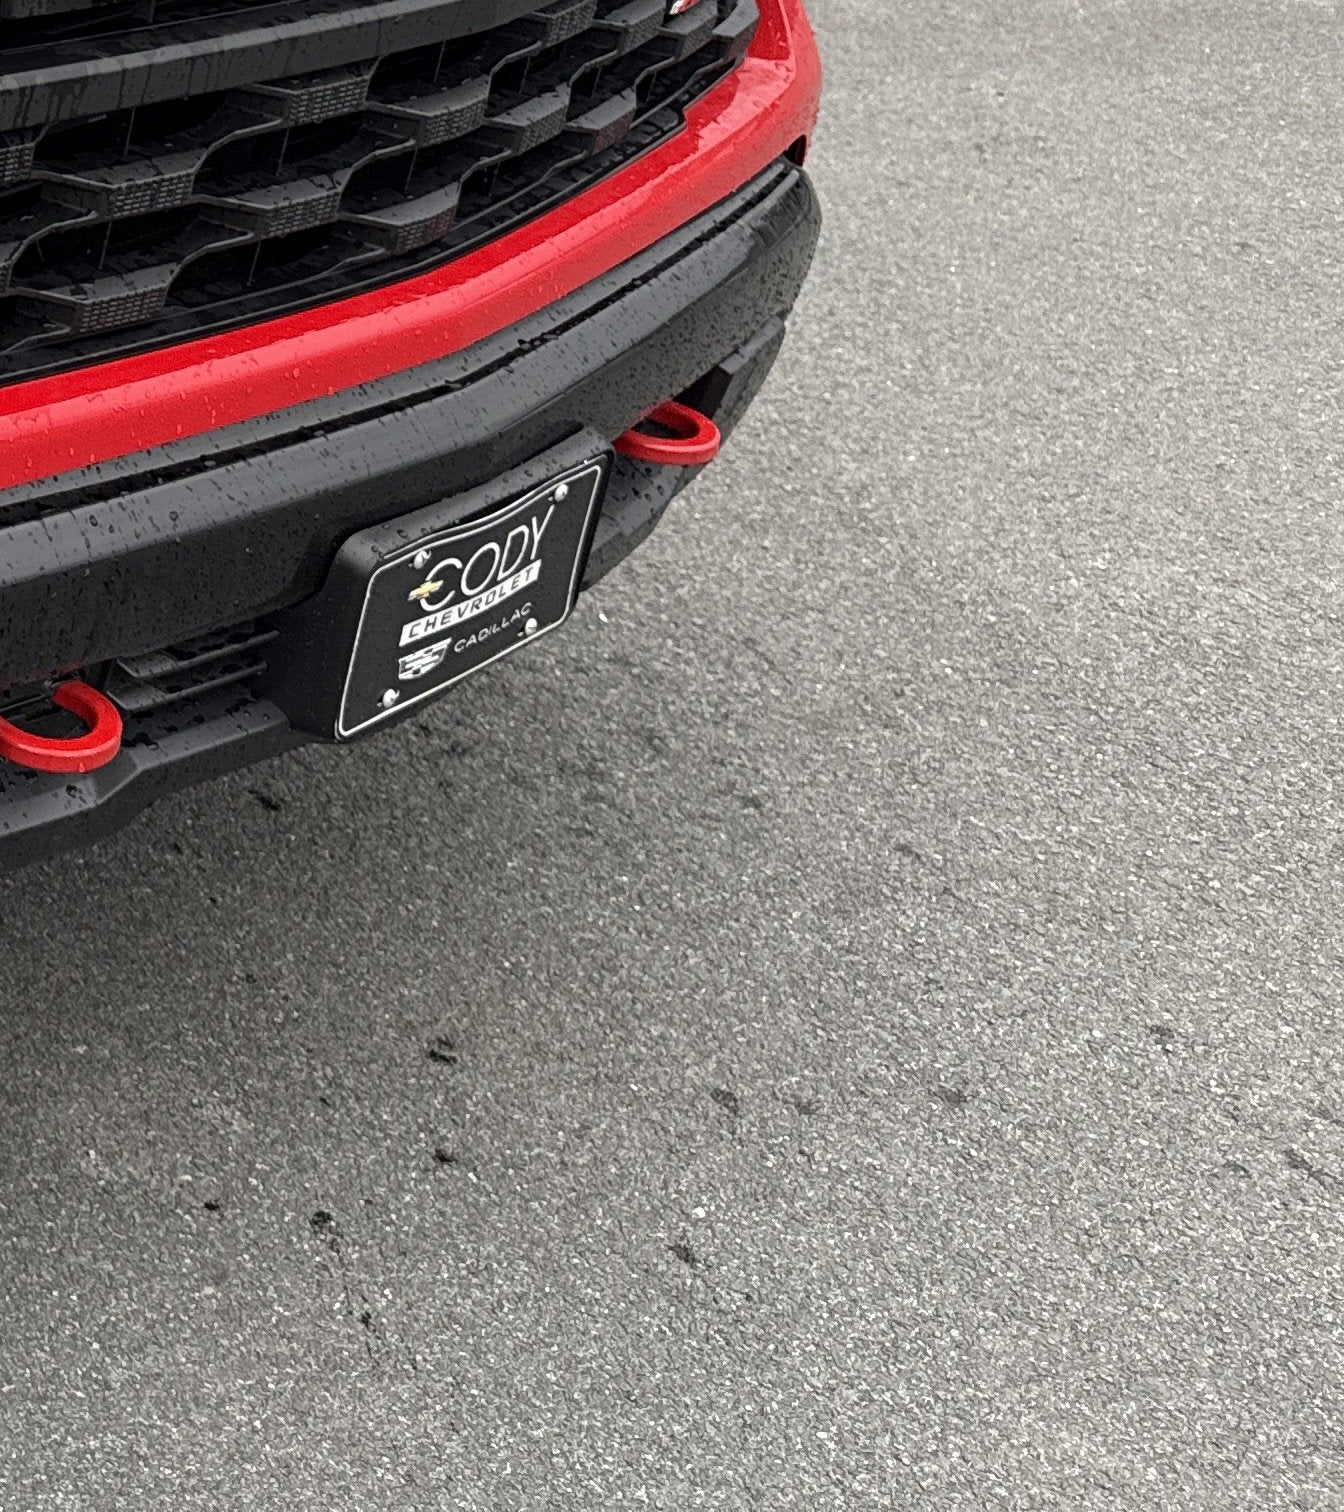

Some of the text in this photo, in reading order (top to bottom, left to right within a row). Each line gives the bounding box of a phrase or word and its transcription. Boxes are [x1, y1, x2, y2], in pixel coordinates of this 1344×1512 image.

[420, 504, 555, 612] CODY
[407, 566, 536, 640] CHEVROLET
[453, 601, 533, 654] CADILLAC
